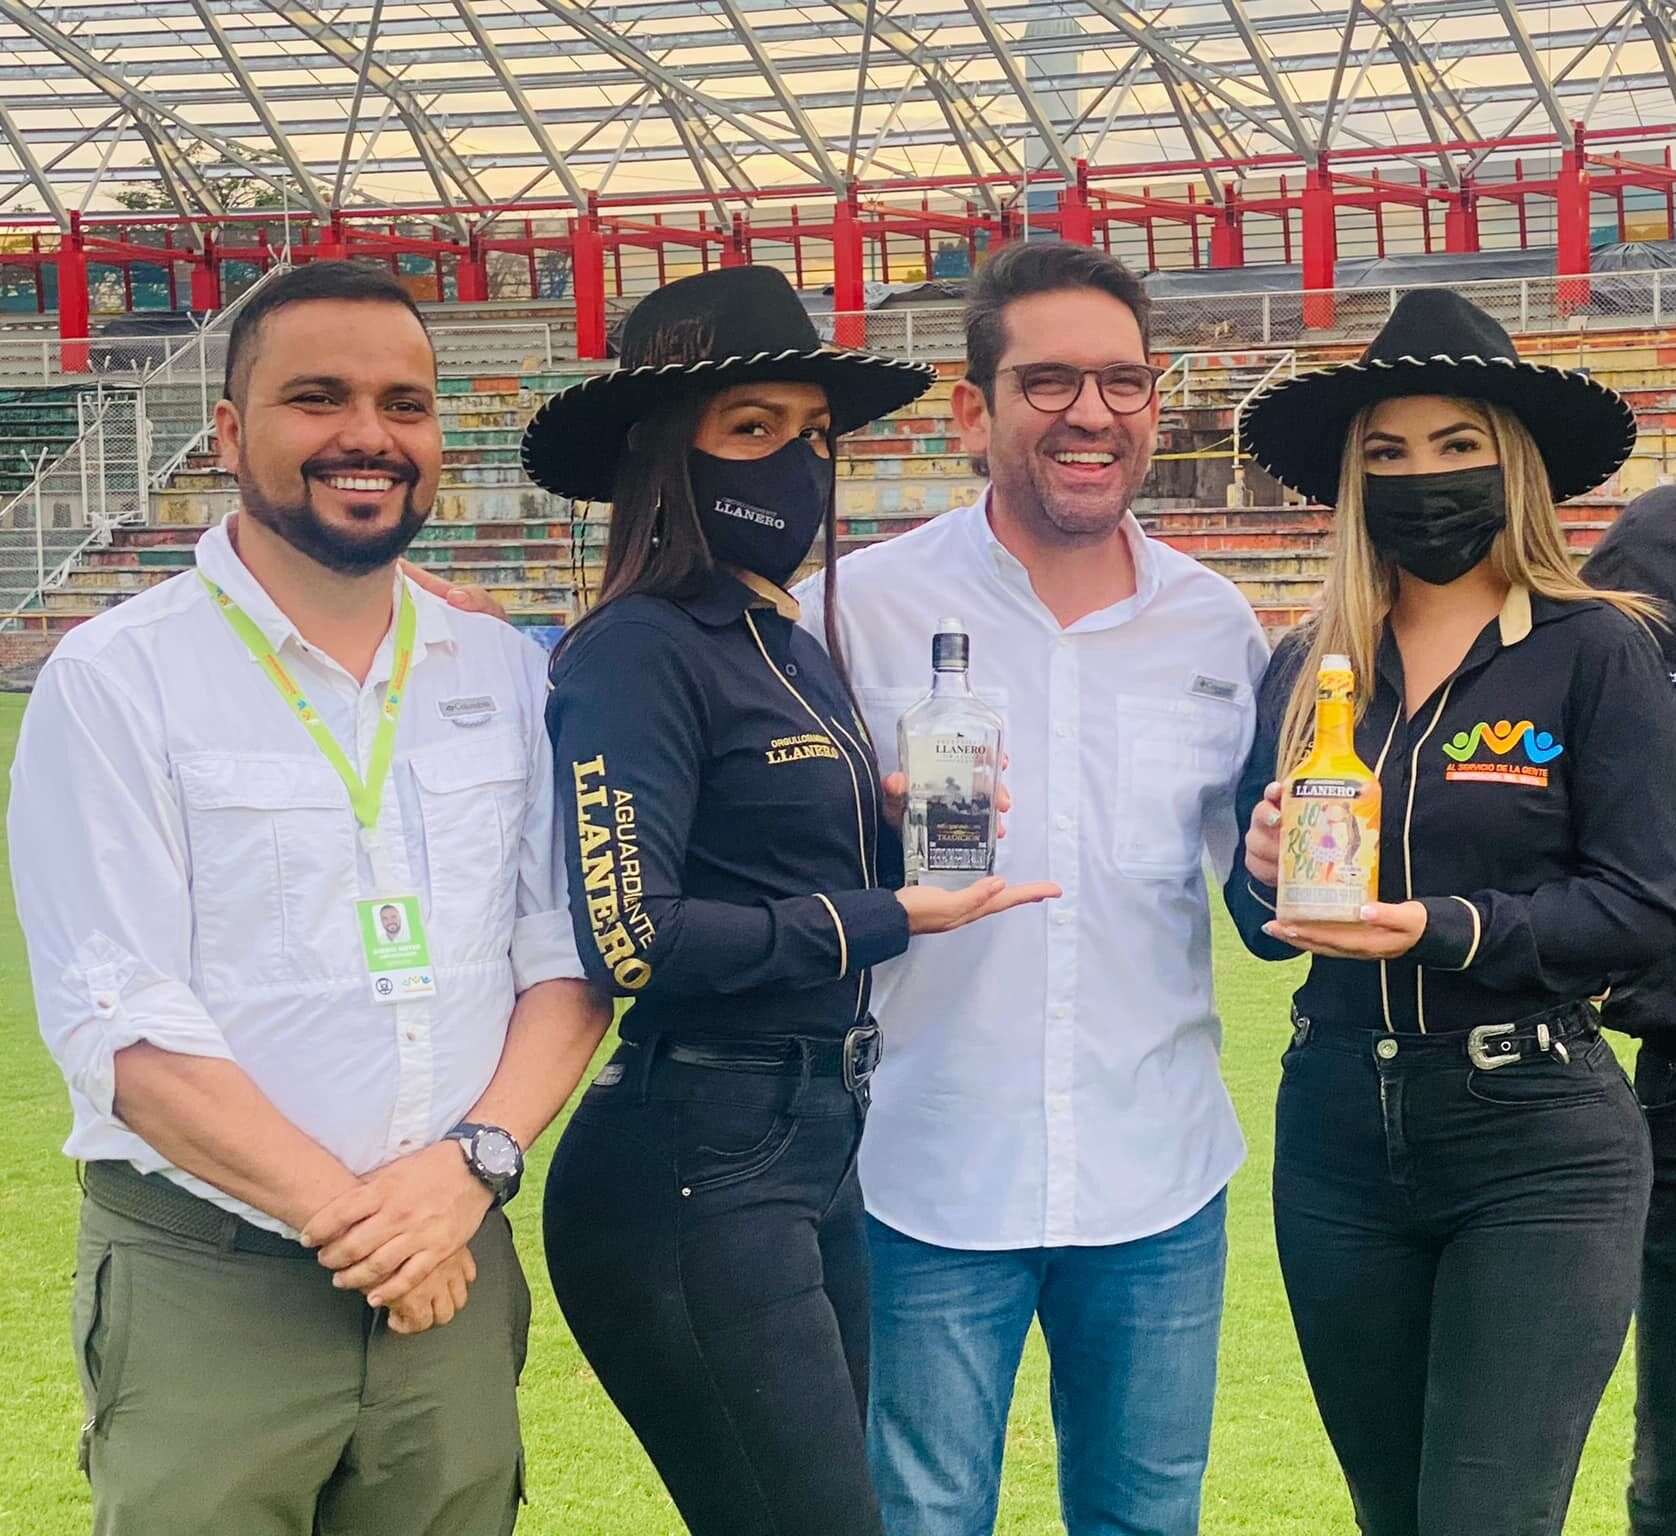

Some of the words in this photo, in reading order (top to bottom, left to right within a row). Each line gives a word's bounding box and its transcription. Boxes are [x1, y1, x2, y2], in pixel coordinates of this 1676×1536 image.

[714, 500, 785, 530] LLANERO
[935, 744, 986, 755] LLANERO
[1457, 763, 1495, 772] SERVICIO
[1496, 764, 1508, 772] DE
[1509, 764, 1521, 773] LA
[1521, 765, 1548, 777] GENTE
[1295, 784, 1356, 797] LLANERO
[572, 754, 652, 989] LLANERO
